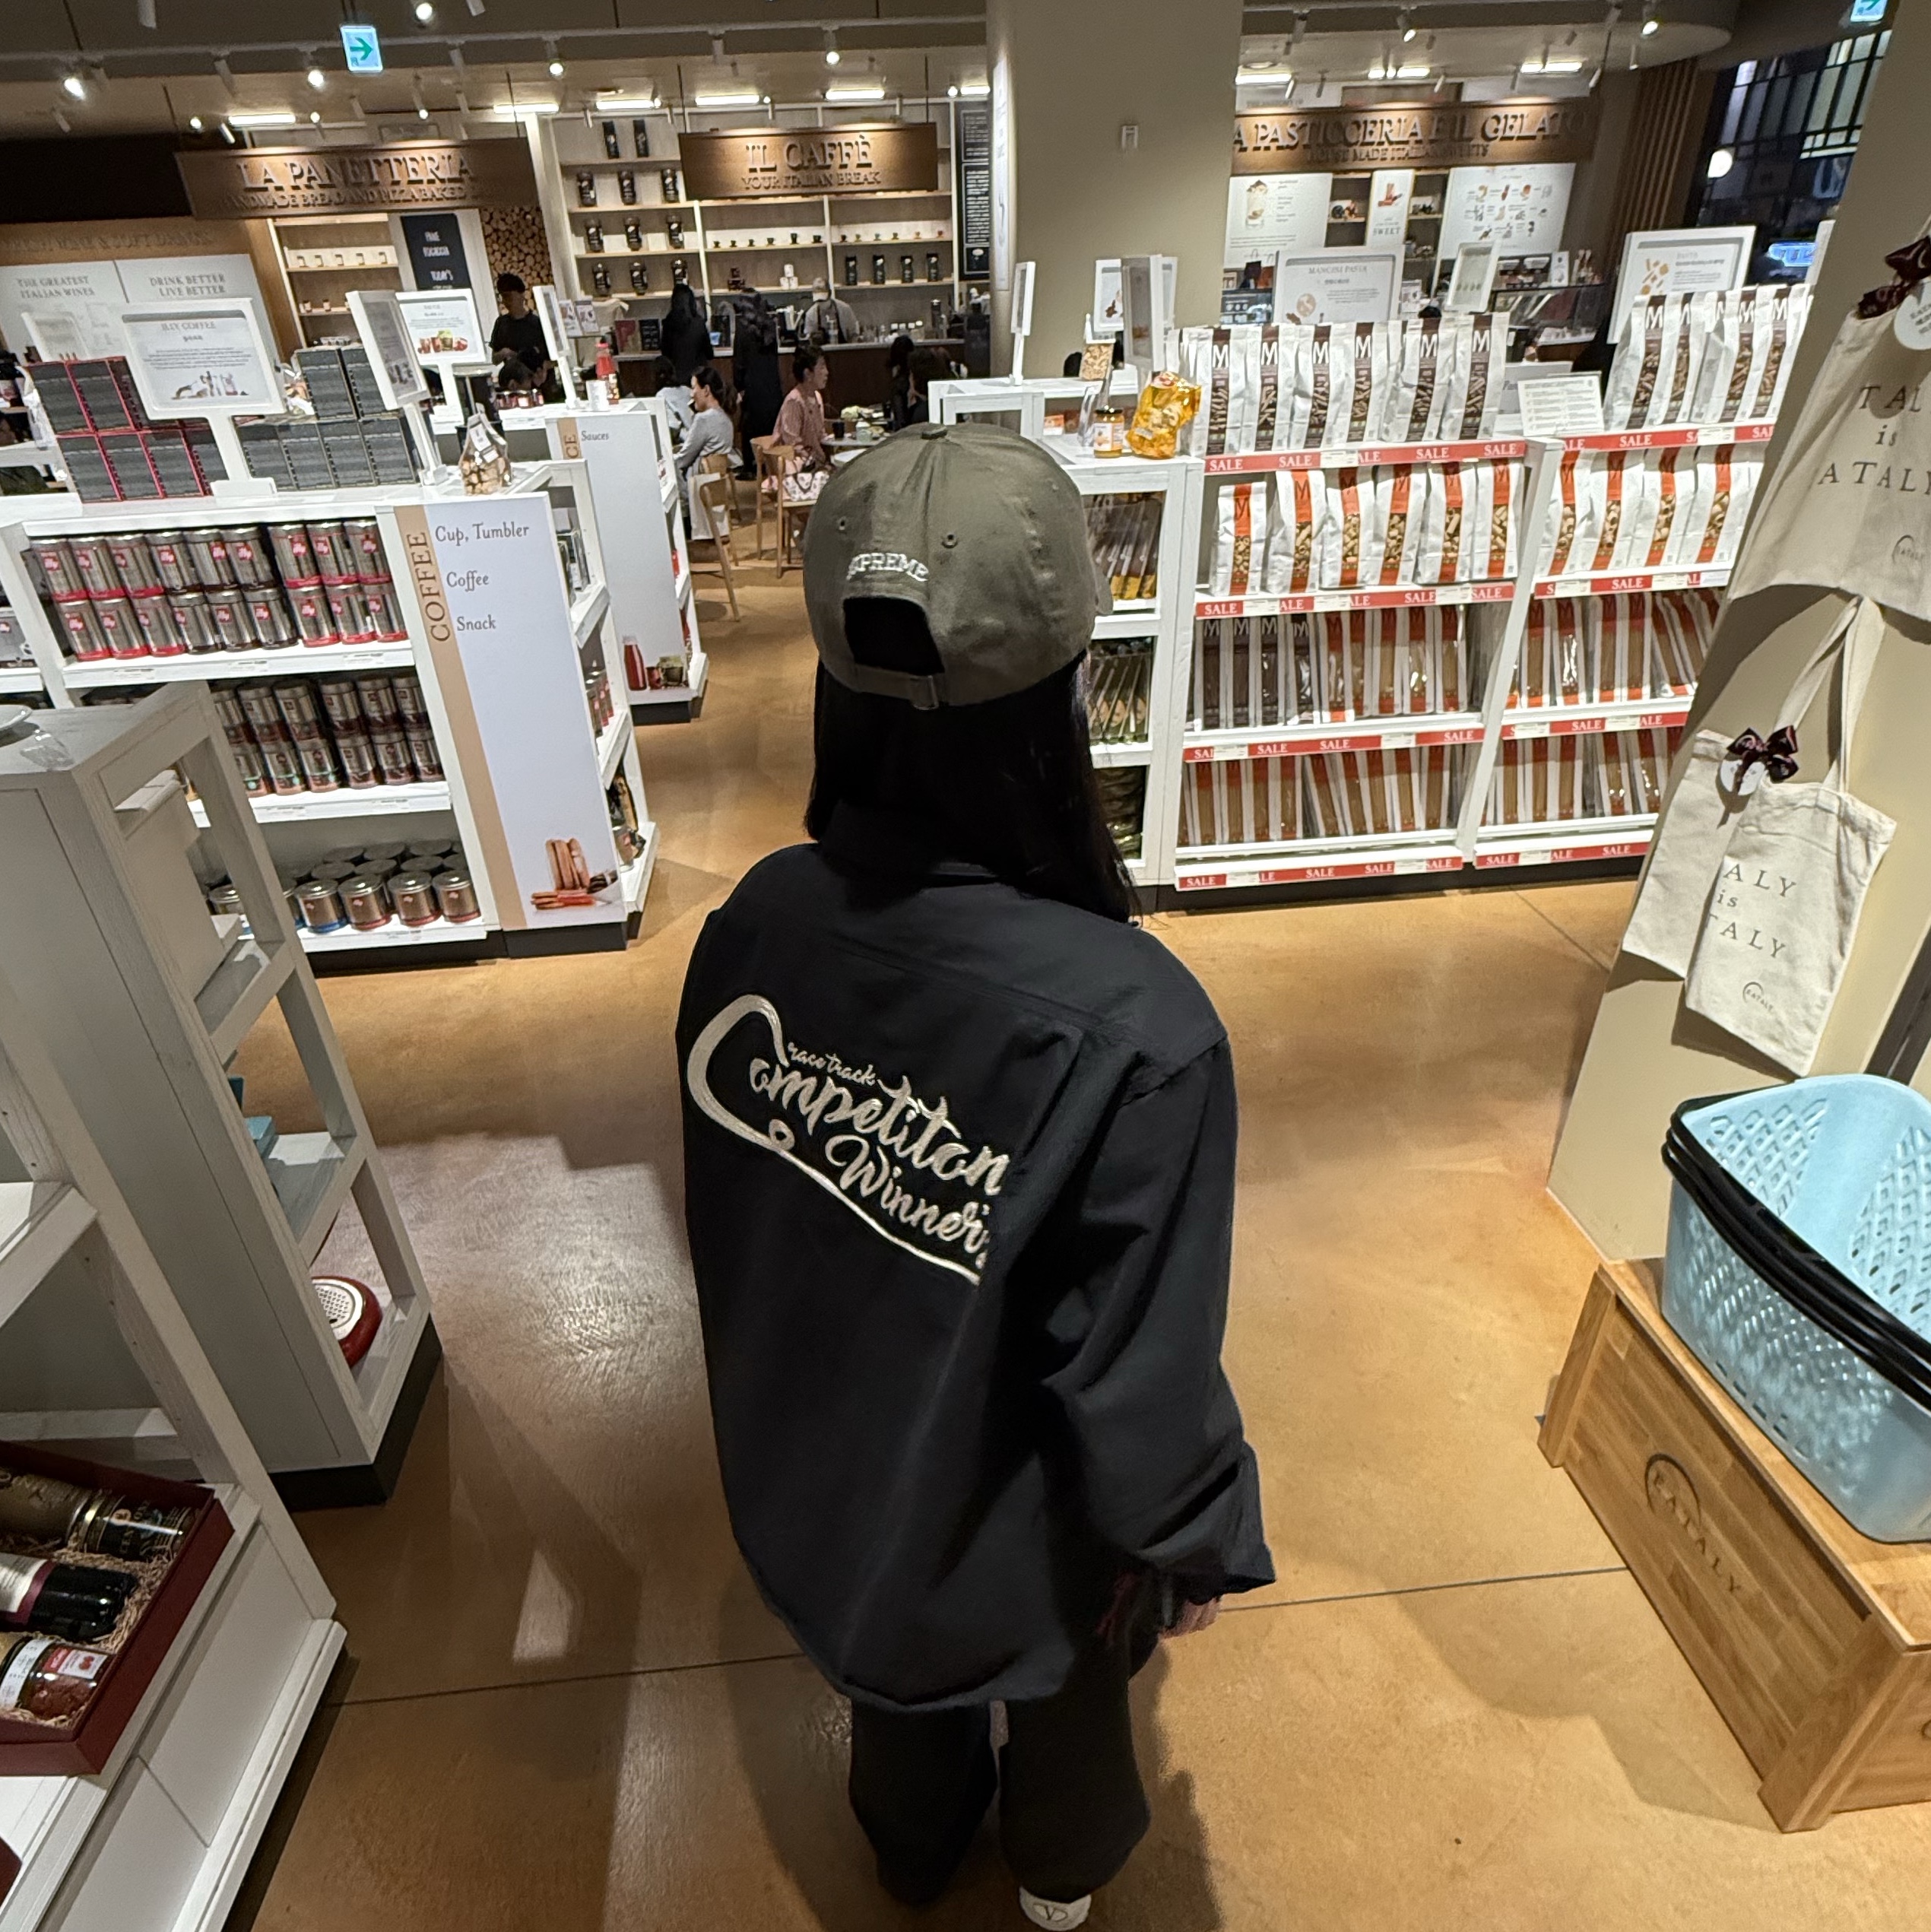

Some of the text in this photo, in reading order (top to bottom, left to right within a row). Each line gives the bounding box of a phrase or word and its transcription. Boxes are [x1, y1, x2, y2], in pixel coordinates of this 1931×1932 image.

[1252, 116, 1423, 152] PASTICCERIA
[746, 134, 872, 172] IL CAFFÈ
[236, 154, 474, 192] LA PANETTERIA
[741, 176, 781, 190] YOUR
[836, 172, 882, 186] BREAK
[150, 274, 226, 287] DRINK BETTER
[159, 285, 226, 297] LIVE BETTER
[1356, 335, 1371, 359] M
[1421, 334, 1438, 357] M
[1473, 329, 1490, 353] M
[1213, 344, 1229, 368] M
[1262, 341, 1279, 365] M
[1312, 341, 1330, 365] M
[1859, 385, 1931, 413] TAL
[581, 430, 610, 441] Sauces
[1619, 434, 1653, 447] SALE
[1752, 427, 1772, 439] SA
[1875, 424, 1898, 446] is
[1209, 443, 1517, 471] SALE SALE ALE SALE SALE
[435, 522, 530, 545] Cup, Tumbler
[407, 531, 451, 643] COFFEE
[446, 571, 490, 593] Coffee
[1612, 578, 1644, 591] SALE
[1205, 602, 1238, 615] SALE
[1280, 599, 1305, 611] ALE
[1405, 591, 1435, 604] SALE
[456, 615, 496, 633] Snack
[1572, 715, 1663, 731] SALE ALE
[1194, 749, 1214, 759] SA
[1257, 744, 1288, 754] SALE
[1320, 739, 1350, 750] SALE
[1444, 731, 1474, 741] SALE
[1486, 845, 1631, 865] SALE ALE SALE
[1187, 876, 1216, 886] SALE
[1261, 872, 1275, 882] LE
[1305, 868, 1335, 878] SALE
[1365, 863, 1394, 874] SALE
[1723, 863, 1796, 897] ALY
[1717, 889, 1739, 907] is
[825, 1053, 877, 1087] track
